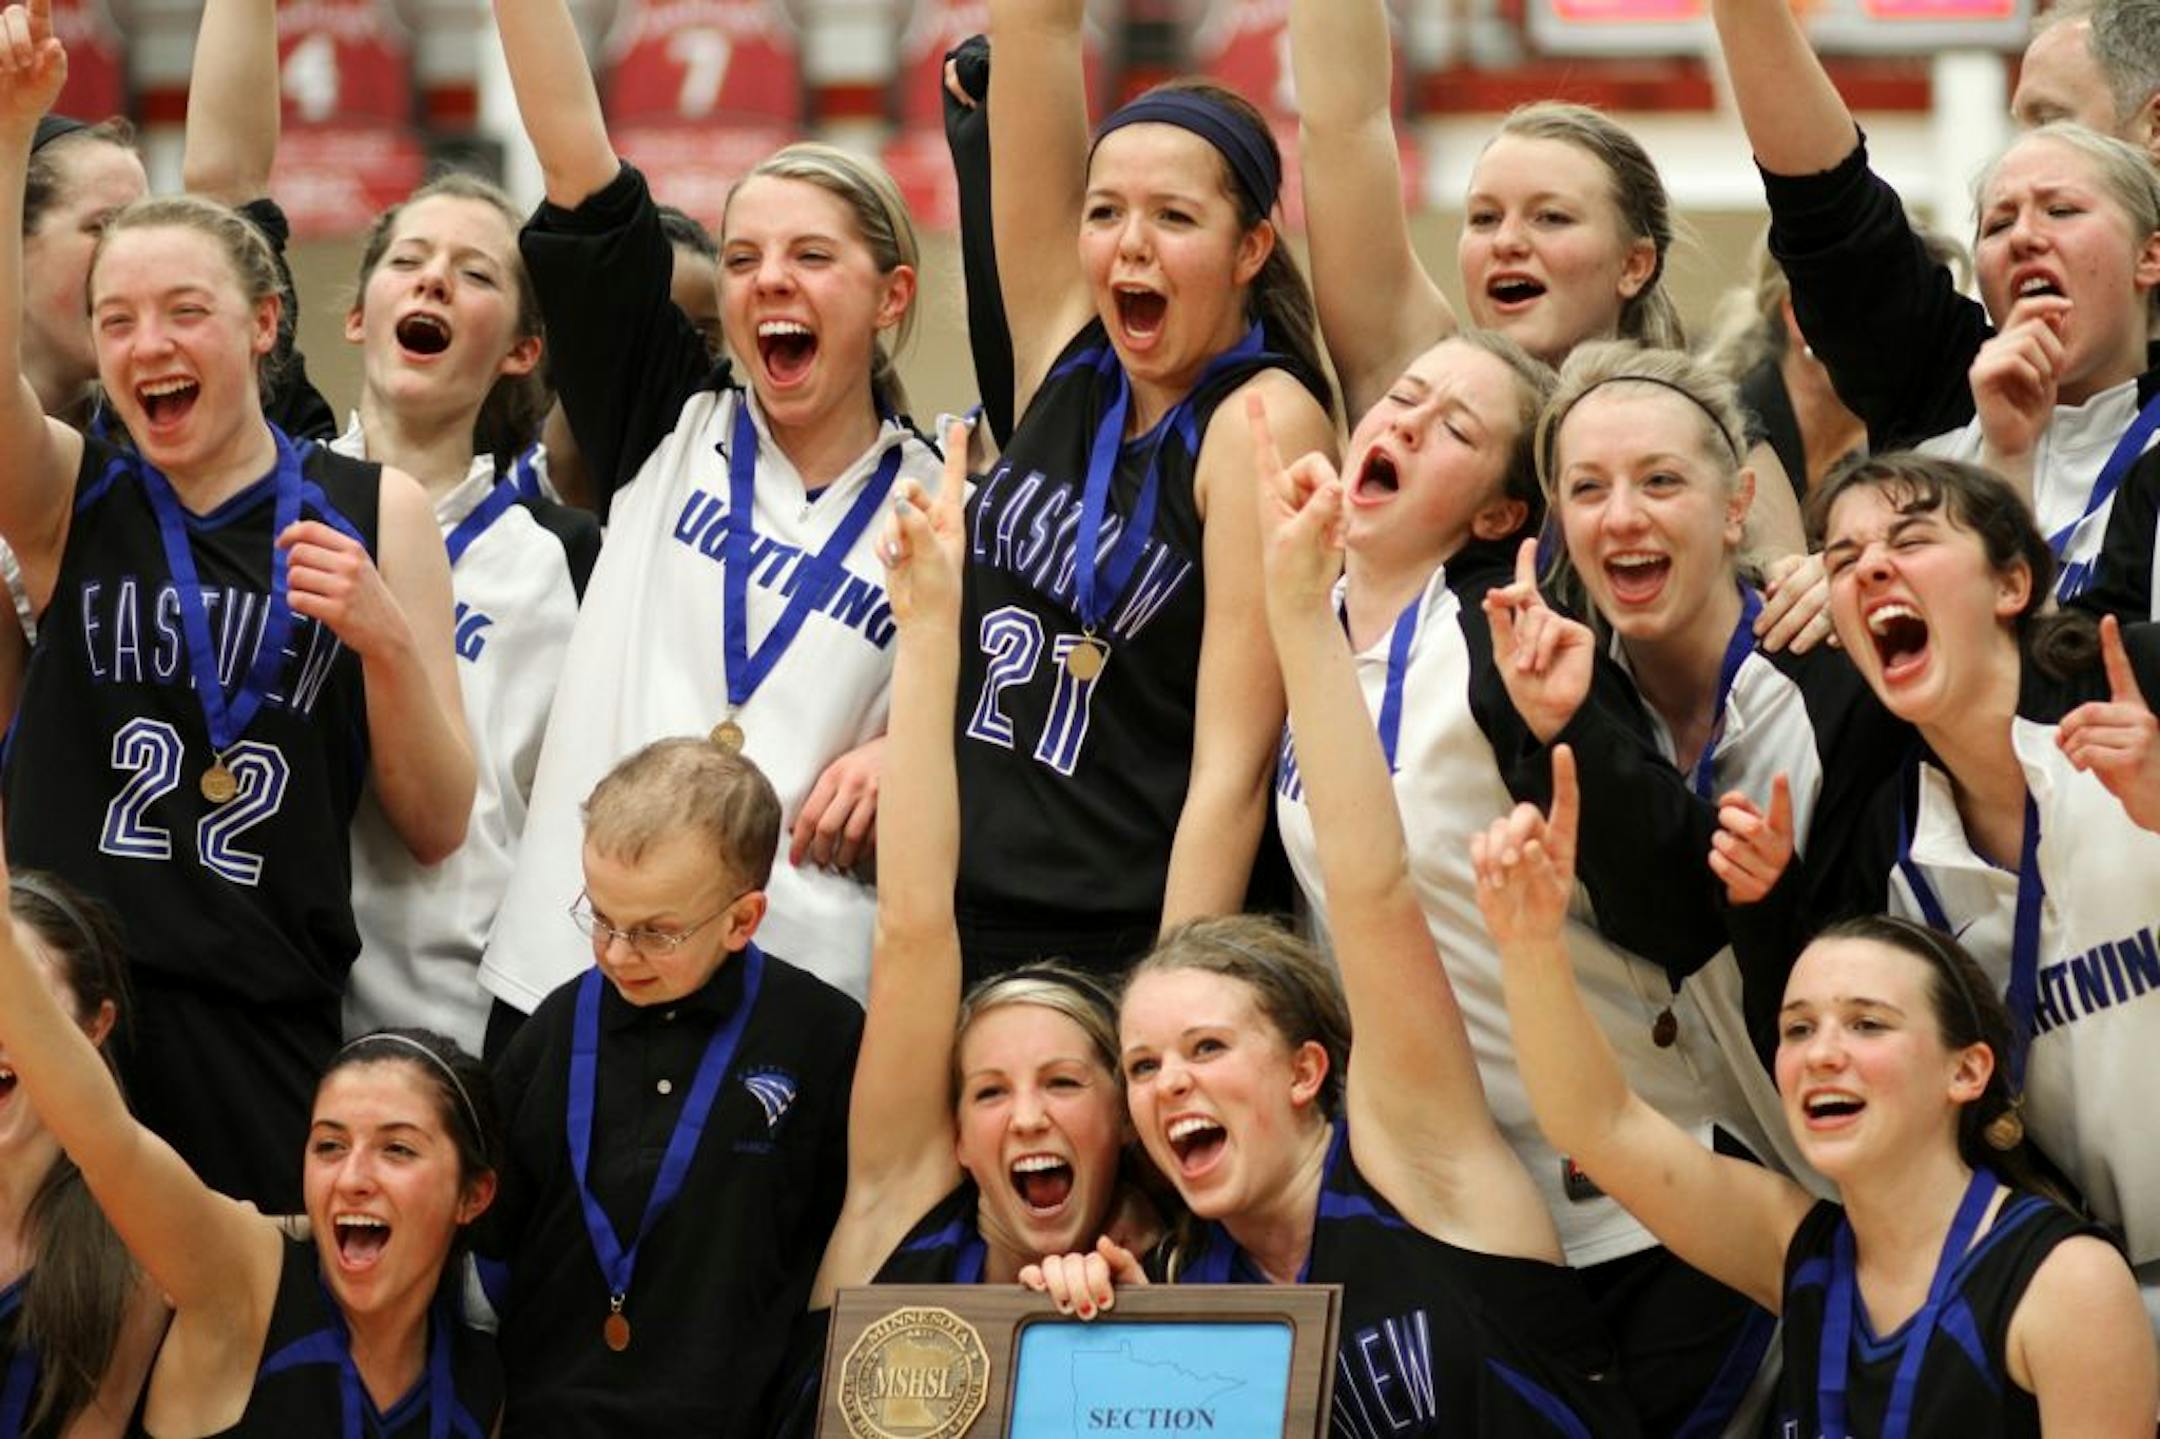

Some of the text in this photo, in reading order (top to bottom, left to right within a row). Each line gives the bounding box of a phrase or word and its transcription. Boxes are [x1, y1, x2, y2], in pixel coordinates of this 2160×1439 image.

[83, 581, 342, 714] EASVIW
[966, 605, 1111, 776] 21
[99, 716, 290, 886] 22
[867, 1310, 970, 1345] MINNESOTA
[873, 1366, 953, 1399] MSHSL
[1088, 1407, 1216, 1430] SECTION
